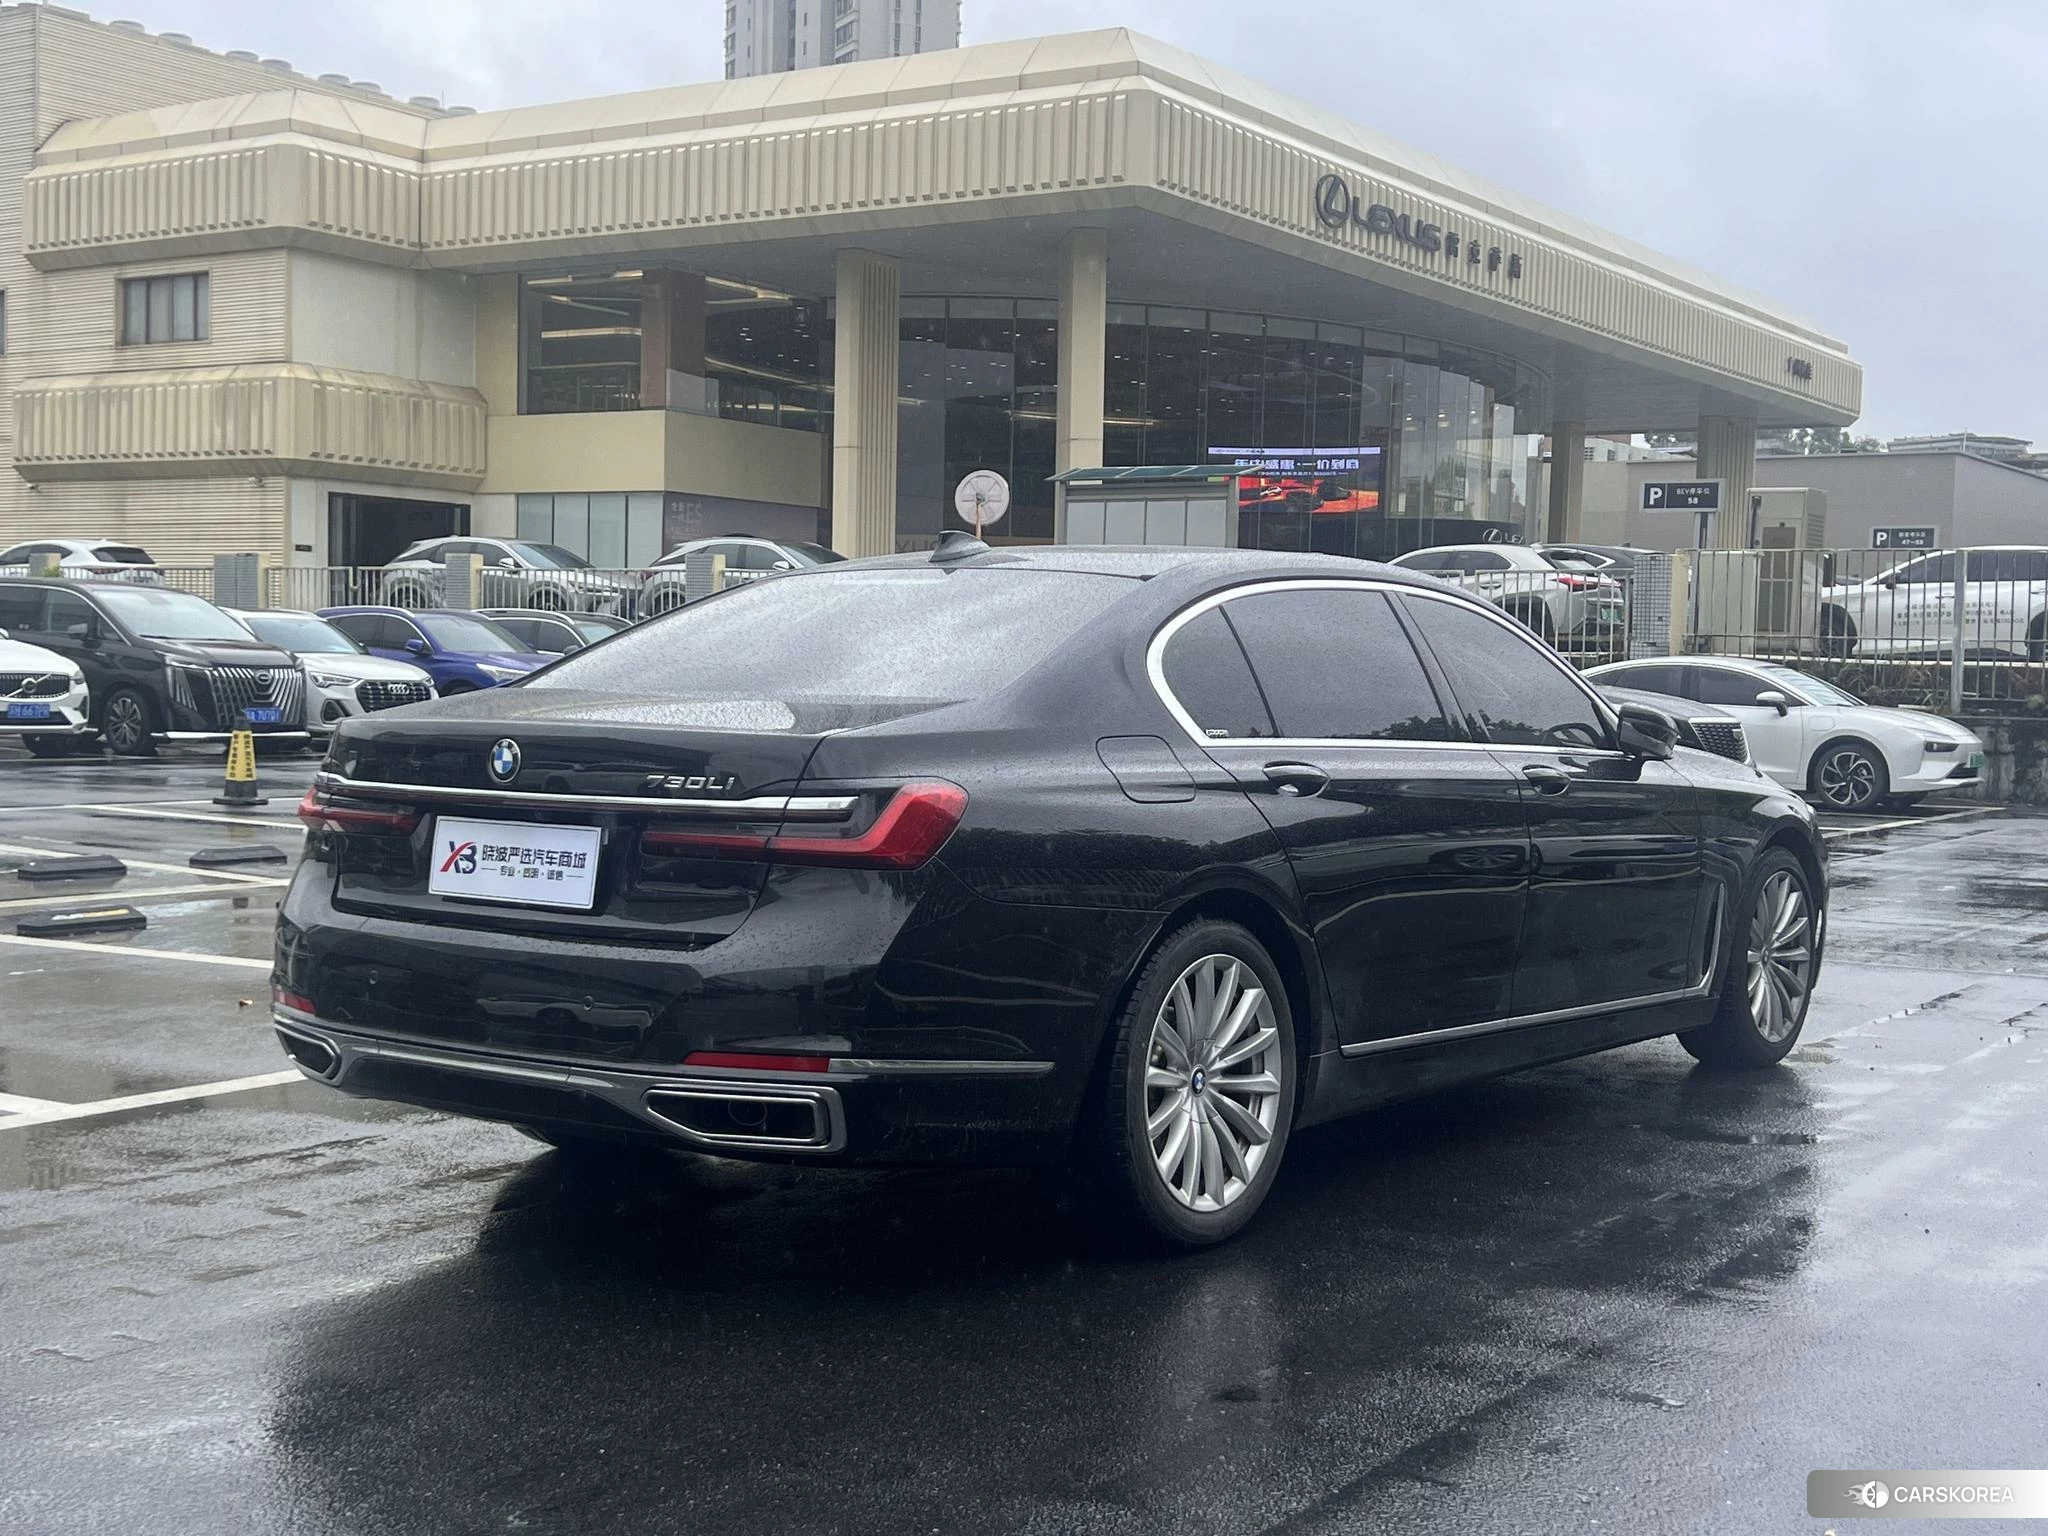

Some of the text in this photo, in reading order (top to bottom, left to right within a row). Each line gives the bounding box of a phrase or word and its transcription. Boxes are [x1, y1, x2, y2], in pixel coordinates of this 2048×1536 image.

[1352, 196, 1442, 252] LEXUS
[1649, 487, 1663, 505] P
[1687, 496, 1699, 504] 58
[1876, 531, 1888, 546] P
[481, 844, 587, 869] 晓波严选汽车商城
